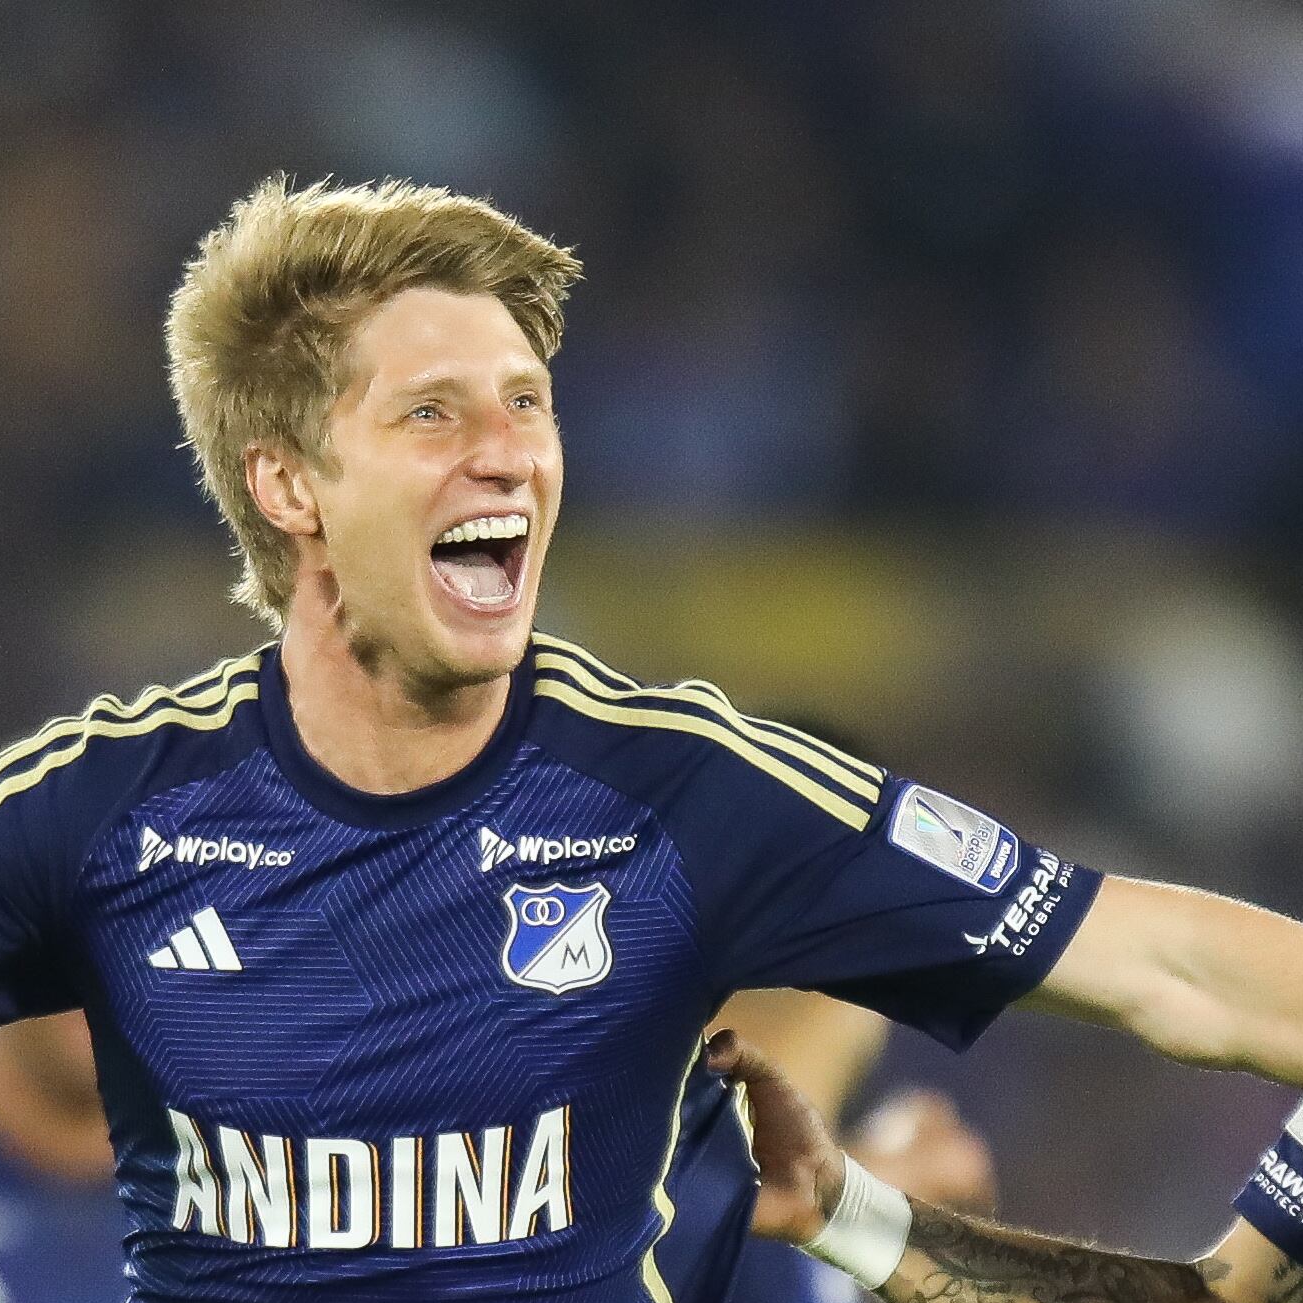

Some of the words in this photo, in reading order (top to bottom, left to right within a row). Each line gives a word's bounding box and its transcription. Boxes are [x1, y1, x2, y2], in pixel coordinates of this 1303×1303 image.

[177, 836, 294, 870] Wplay.co
[520, 835, 637, 865] Wplay.co
[1012, 893, 1062, 956] GLOBAL
[561, 941, 590, 970] M
[168, 1104, 573, 1249] ANDINA
